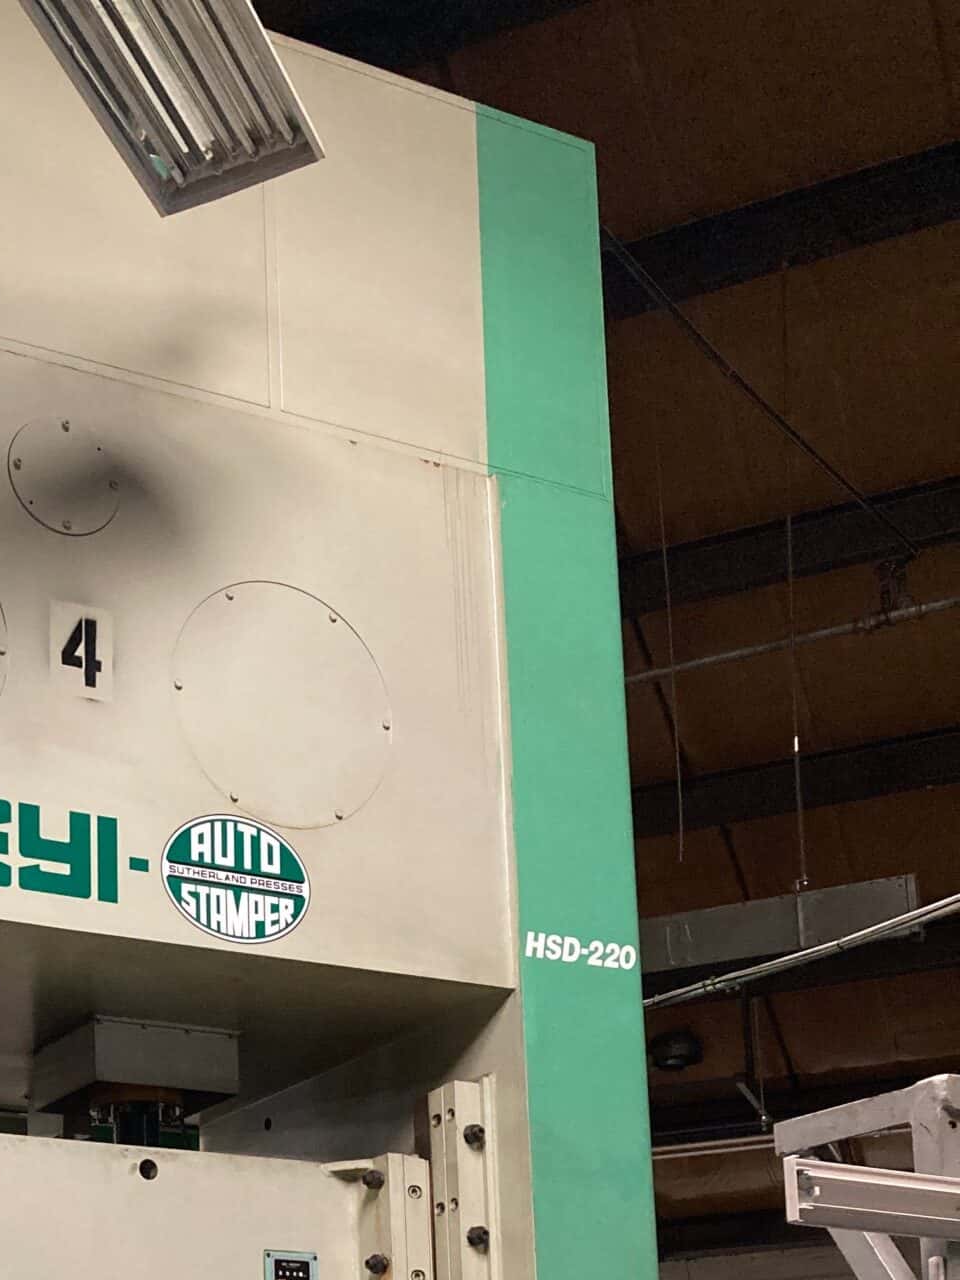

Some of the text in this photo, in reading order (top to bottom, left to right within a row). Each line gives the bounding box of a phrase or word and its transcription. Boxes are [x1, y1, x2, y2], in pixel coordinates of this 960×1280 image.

[61, 617, 102, 688] 4
[191, 821, 280, 874] AUTO
[169, 865, 304, 894] SUTHERLAND PRESSES
[180, 882, 295, 938] STAMPER
[525, 931, 637, 970] HSD-220
